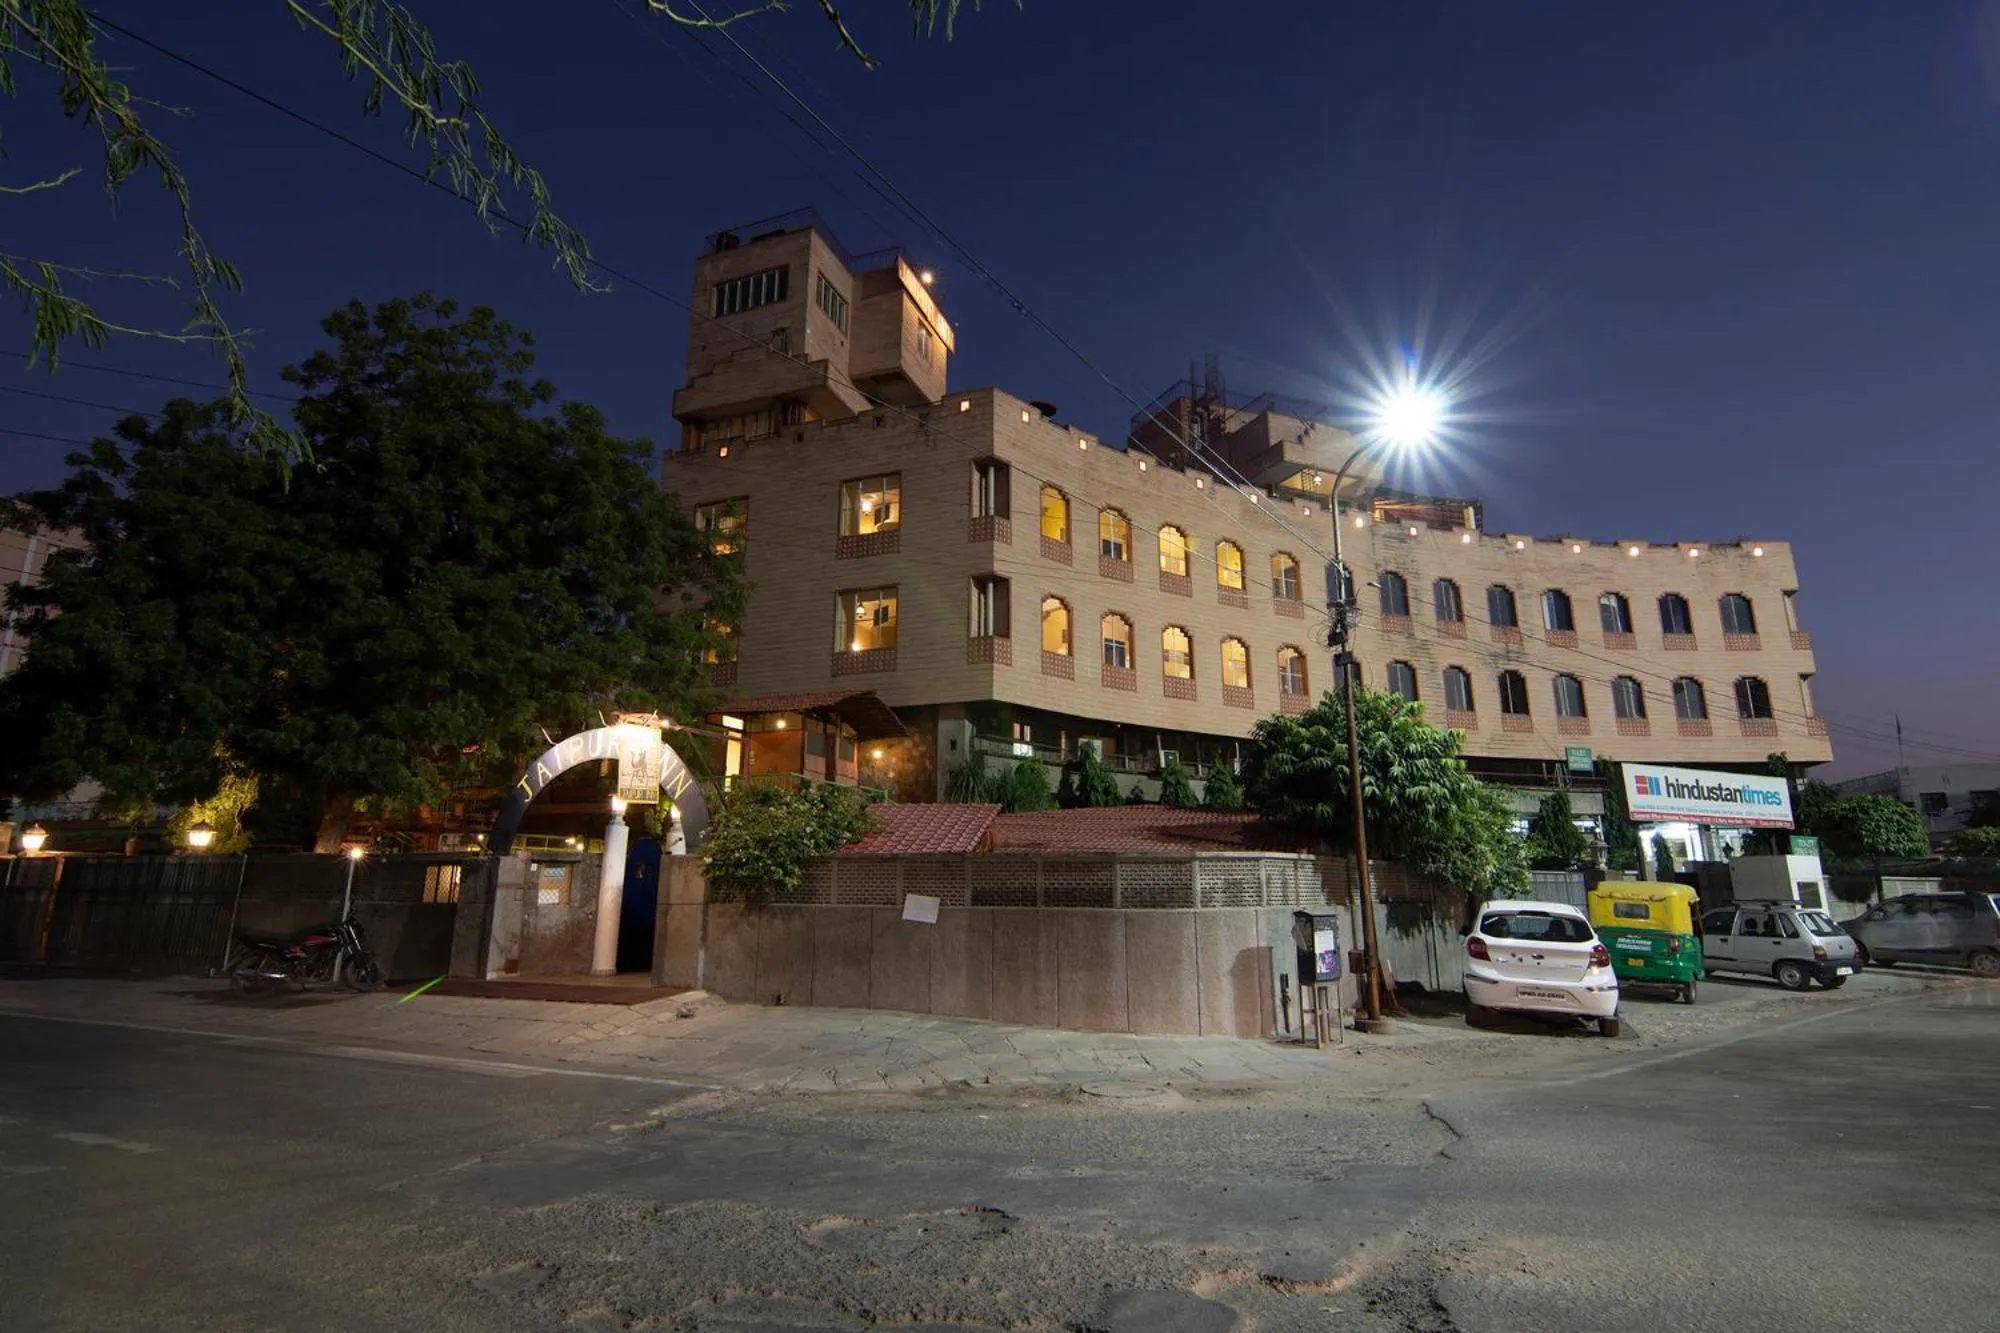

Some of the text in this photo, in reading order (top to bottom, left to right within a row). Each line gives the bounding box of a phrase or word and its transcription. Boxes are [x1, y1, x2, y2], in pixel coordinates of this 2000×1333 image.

[517, 730, 693, 802] JAIPUR NN
[1664, 775, 1782, 805] hindustantimes
